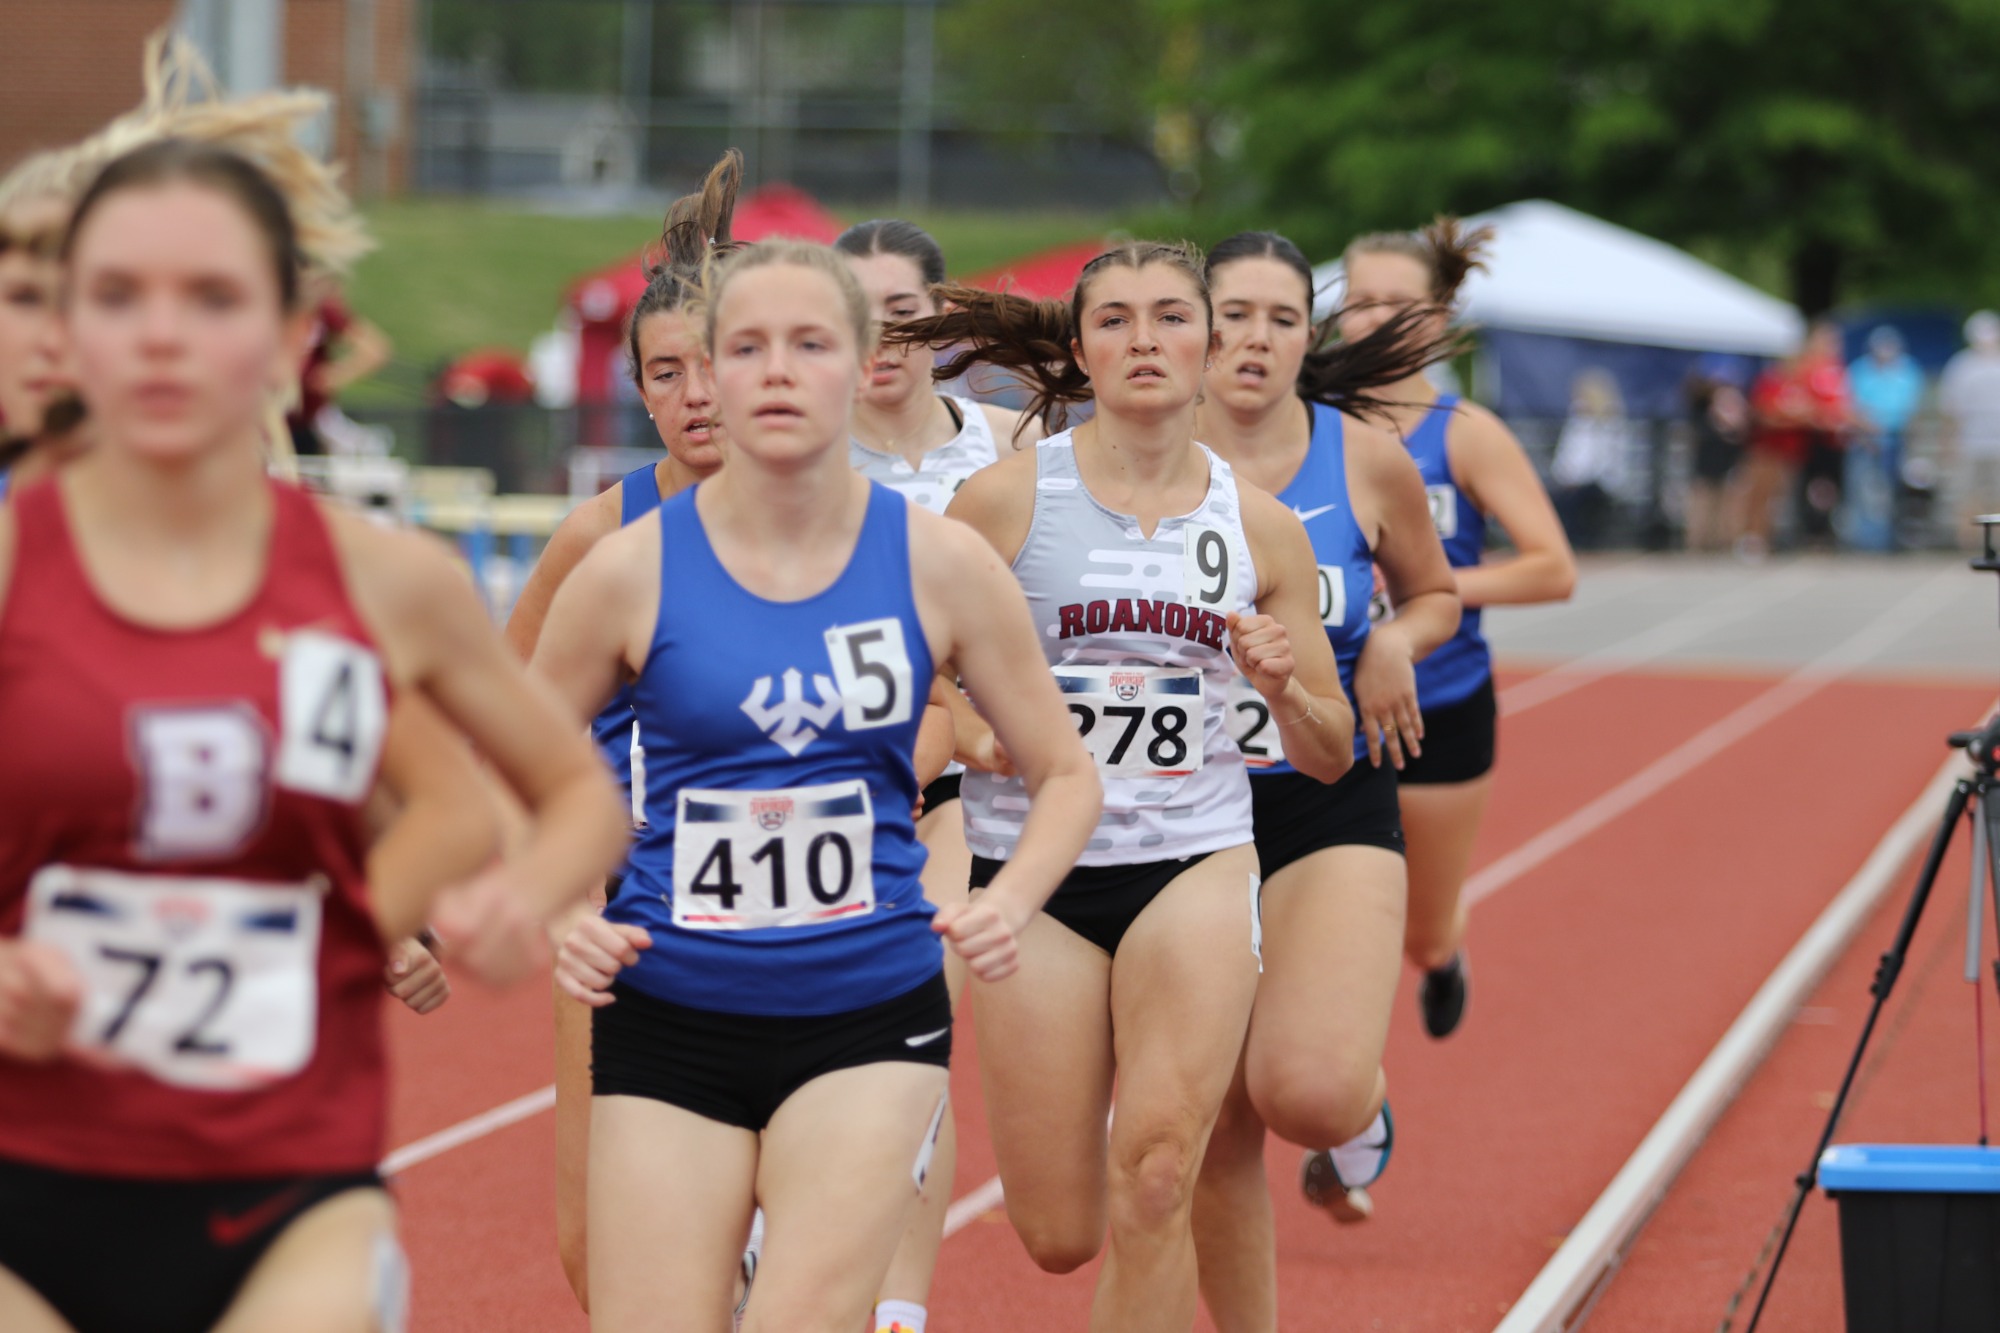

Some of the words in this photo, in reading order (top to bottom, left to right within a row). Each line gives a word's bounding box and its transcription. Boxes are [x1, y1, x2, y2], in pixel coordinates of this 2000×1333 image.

[1196, 530, 1229, 604] 9
[1058, 598, 1227, 652] ROANOKE
[307, 660, 357, 778] 4
[845, 628, 897, 722] 5
[128, 700, 272, 860] B
[689, 831, 853, 910] 410
[97, 944, 236, 1055] 72
